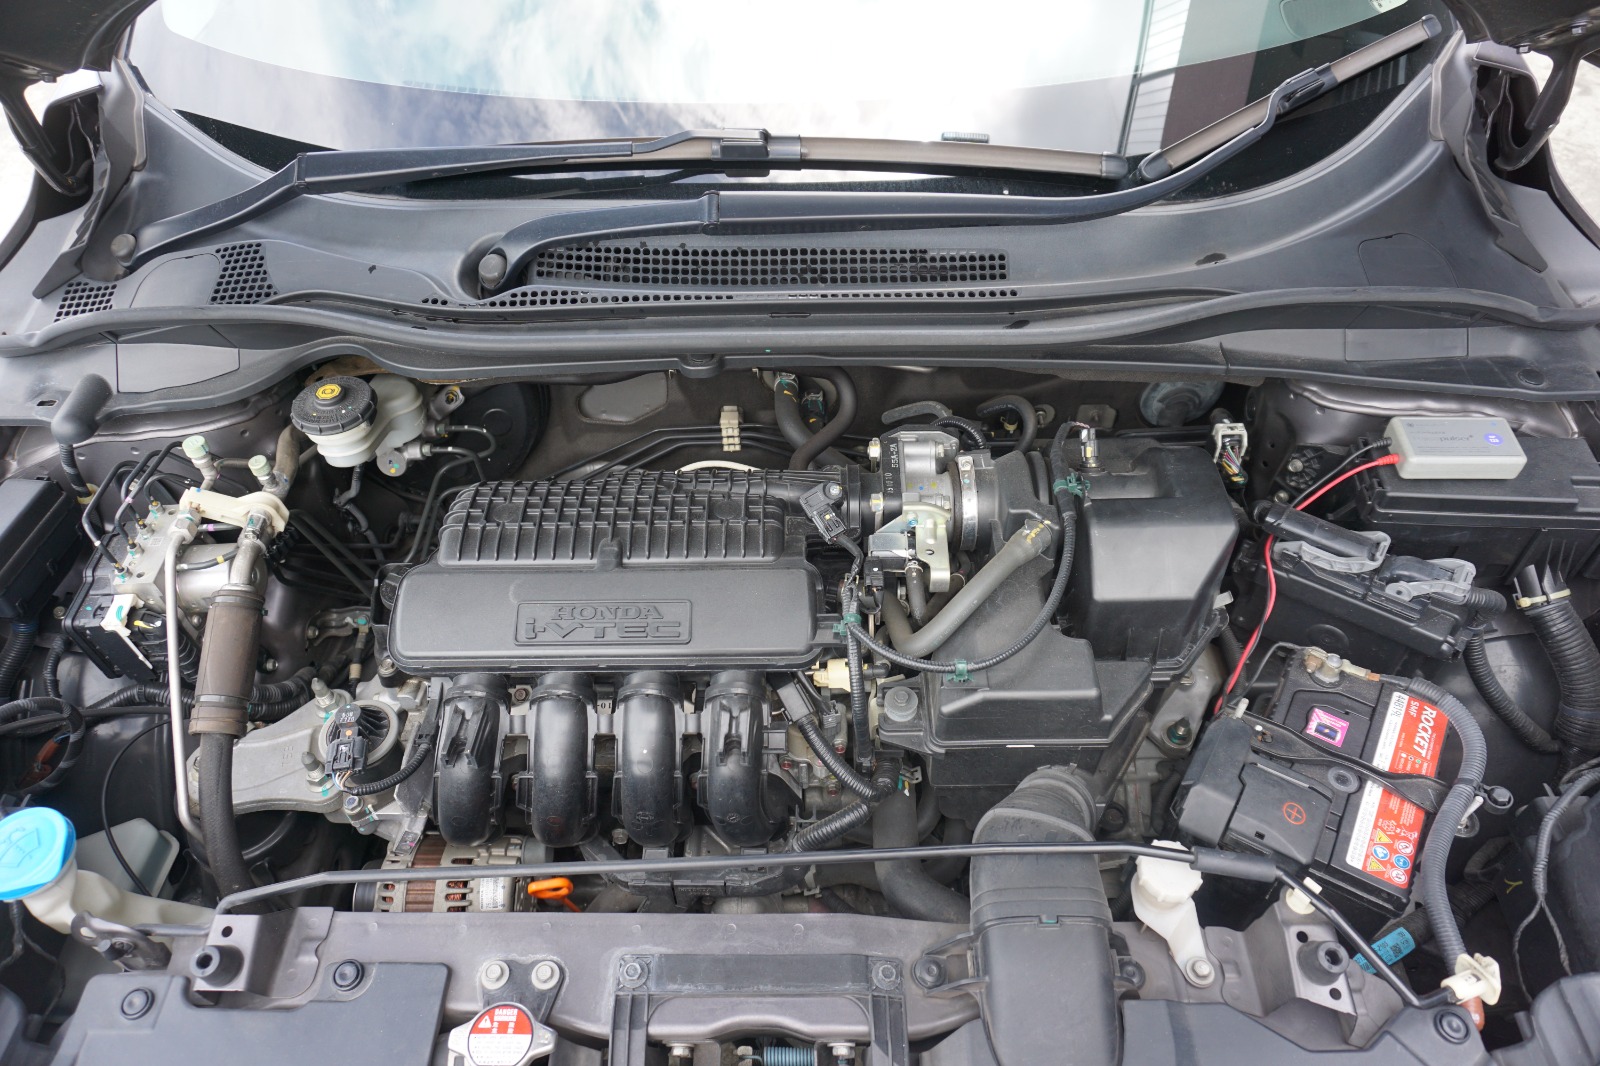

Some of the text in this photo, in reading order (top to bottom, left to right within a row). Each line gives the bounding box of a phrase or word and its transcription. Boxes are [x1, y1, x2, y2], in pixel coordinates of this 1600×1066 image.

[550, 605, 664, 621] HONDA
[525, 617, 681, 640] i-VTEC
[1408, 700, 1420, 718] SMF
[1412, 705, 1437, 758] ROCKET
